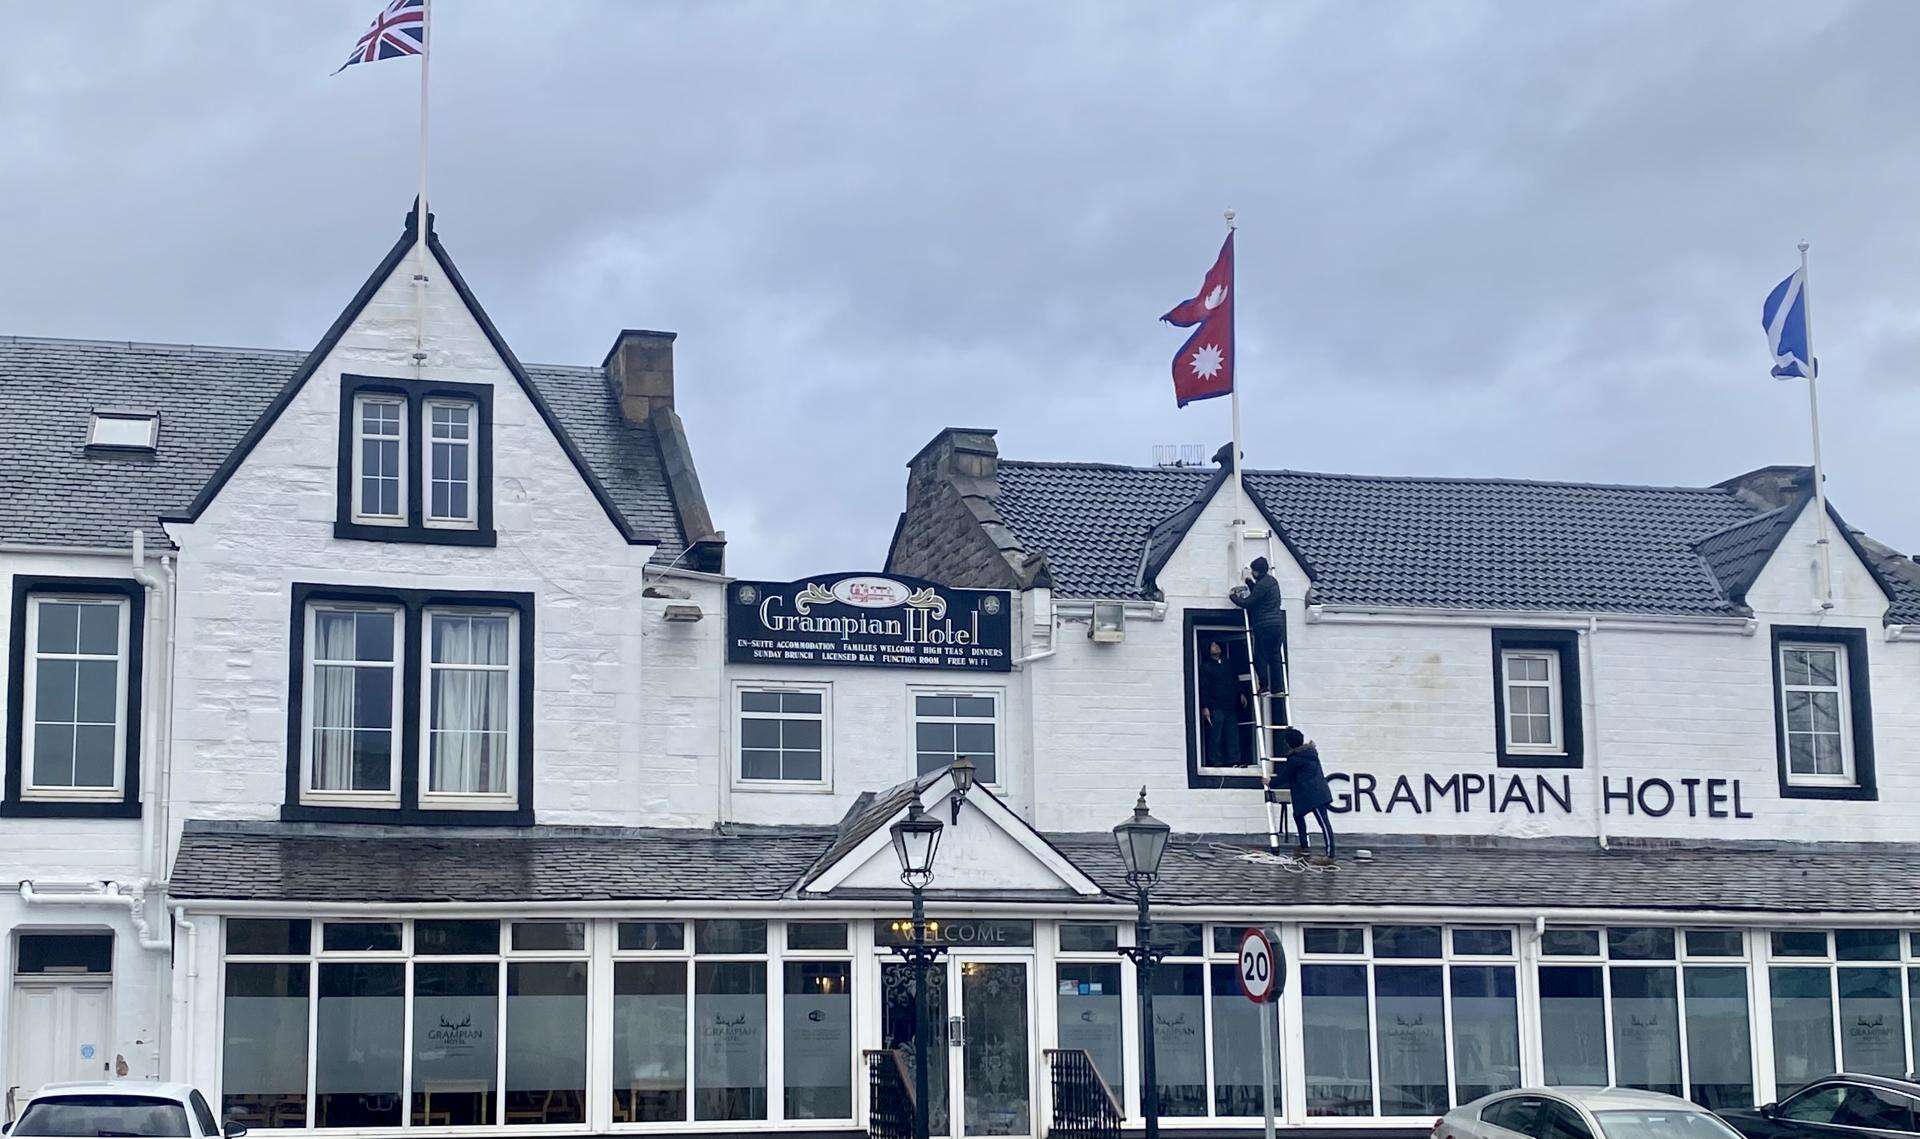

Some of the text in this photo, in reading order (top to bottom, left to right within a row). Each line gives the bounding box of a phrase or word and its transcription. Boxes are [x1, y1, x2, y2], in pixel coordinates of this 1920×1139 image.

[760, 595, 980, 645] Grampian Hotel
[737, 639, 774, 649] EN-SUITE
[843, 642, 878, 653] FAMILIES
[880, 644, 916, 654] WELCOME
[923, 646, 942, 655] HIGH
[944, 647, 964, 656] TEAS
[971, 648, 1003, 657] DINNERS
[753, 650, 782, 660] SUNDAY
[784, 650, 814, 660] BRUNCH
[822, 652, 857, 662] LICENSED
[859, 653, 875, 663] BAR
[882, 654, 917, 664] FUNCTION
[919, 655, 940, 665] ROOM
[947, 657, 966, 666] FREE
[1325, 772, 1753, 818] GRAMPIAN HOTEL
[1244, 952, 1268, 981] 20
